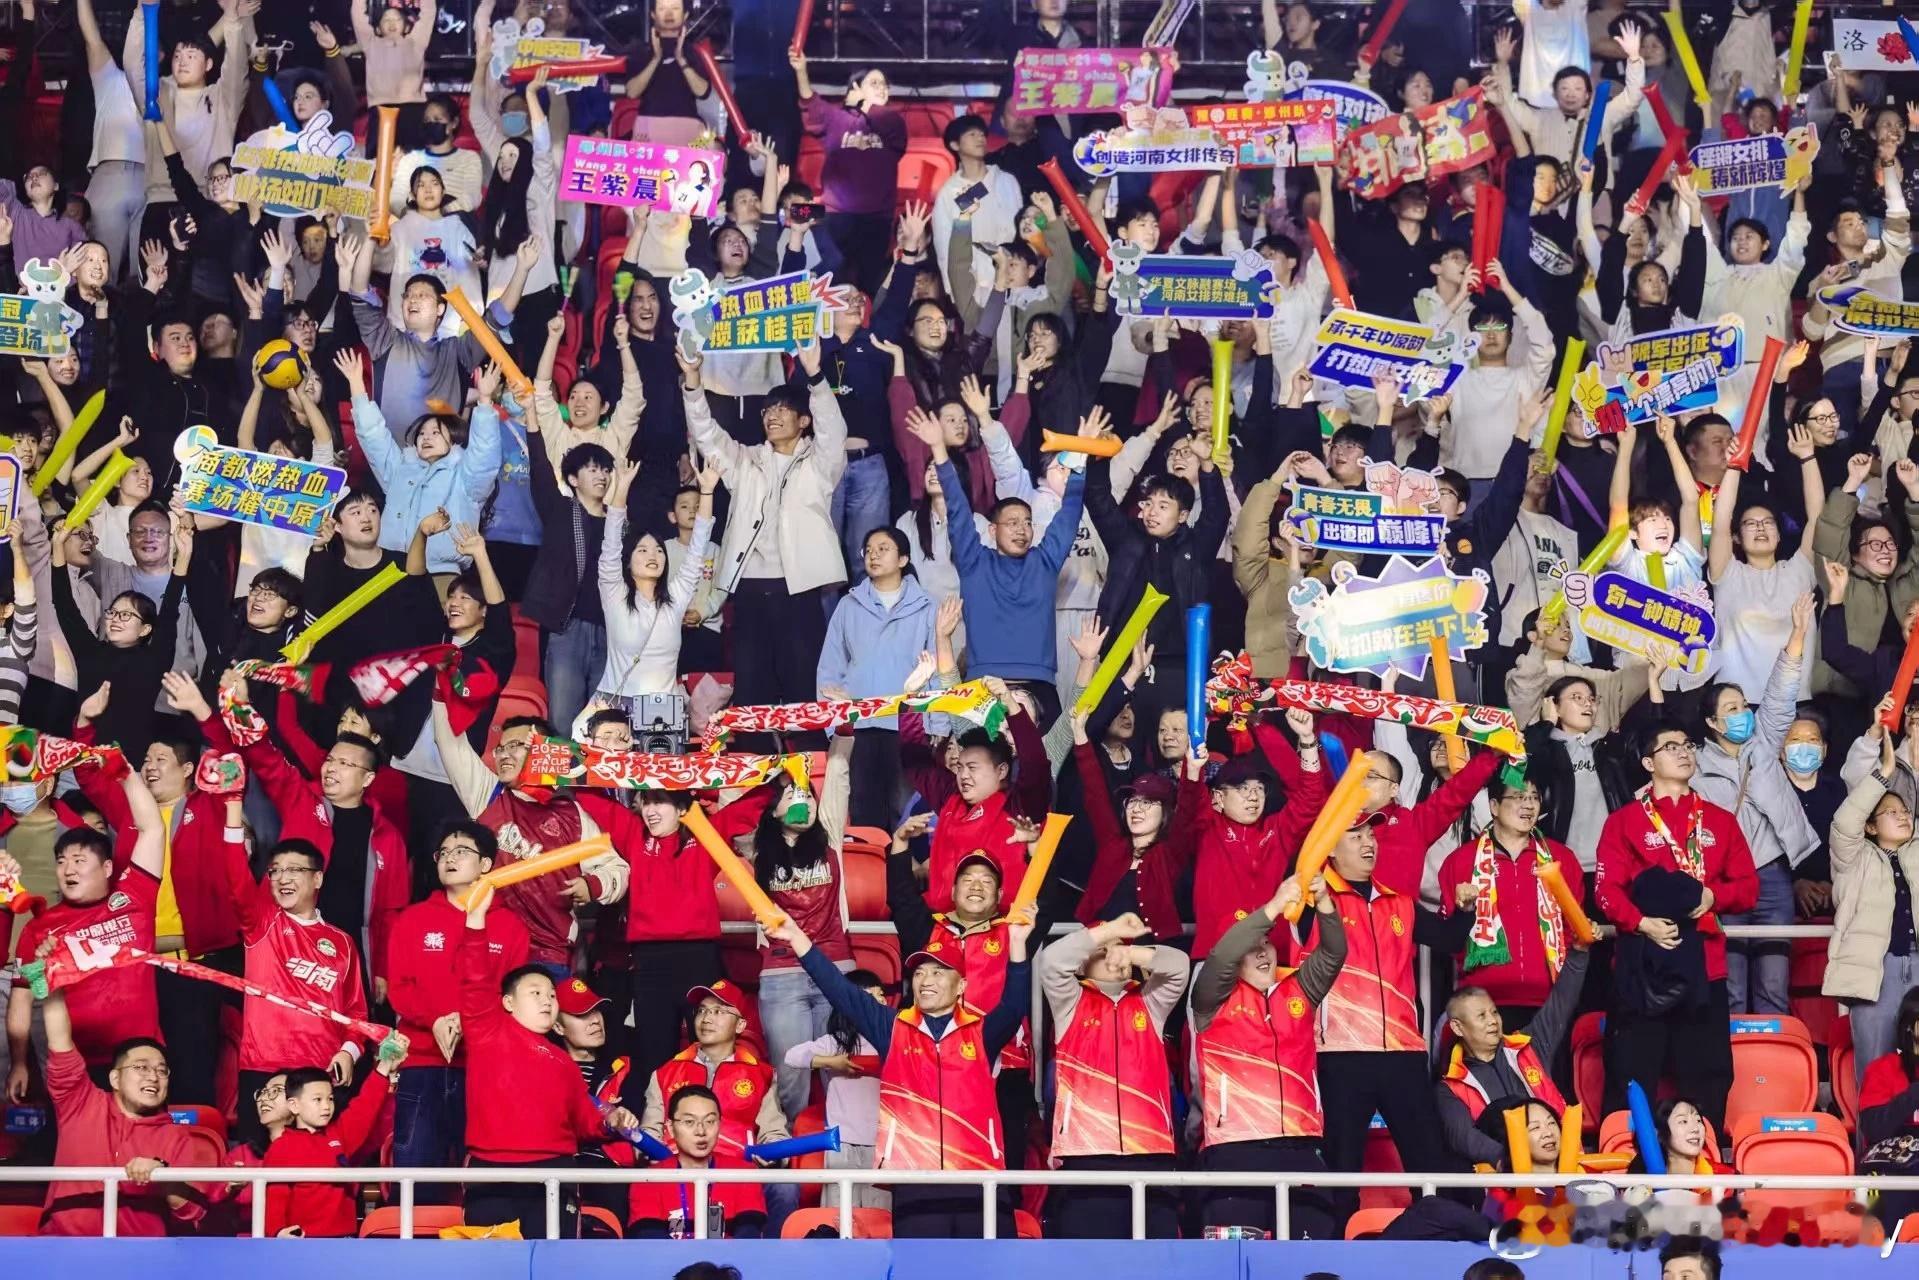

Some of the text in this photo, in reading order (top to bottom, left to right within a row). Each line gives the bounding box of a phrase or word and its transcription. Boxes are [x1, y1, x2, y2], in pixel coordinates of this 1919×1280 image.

[1843, 29, 1869, 51] 洛
[574, 158, 607, 171] Wang
[614, 162, 626, 173] Zi
[1095, 147, 1235, 167] 创造河南女排传奇
[567, 170, 660, 202] 王紫晨
[1151, 277, 1237, 292] 华夏文脉融赛场
[719, 279, 812, 319] 热血拼搏
[1605, 583, 1703, 638] 有一种精神
[1472, 706, 1516, 733] HENA
[531, 743, 571, 755] 2025
[530, 765, 570, 774] FINALS
[550, 757, 571, 767] CUP
[1475, 838, 1495, 943] HENAN
[285, 956, 340, 993] 河南
